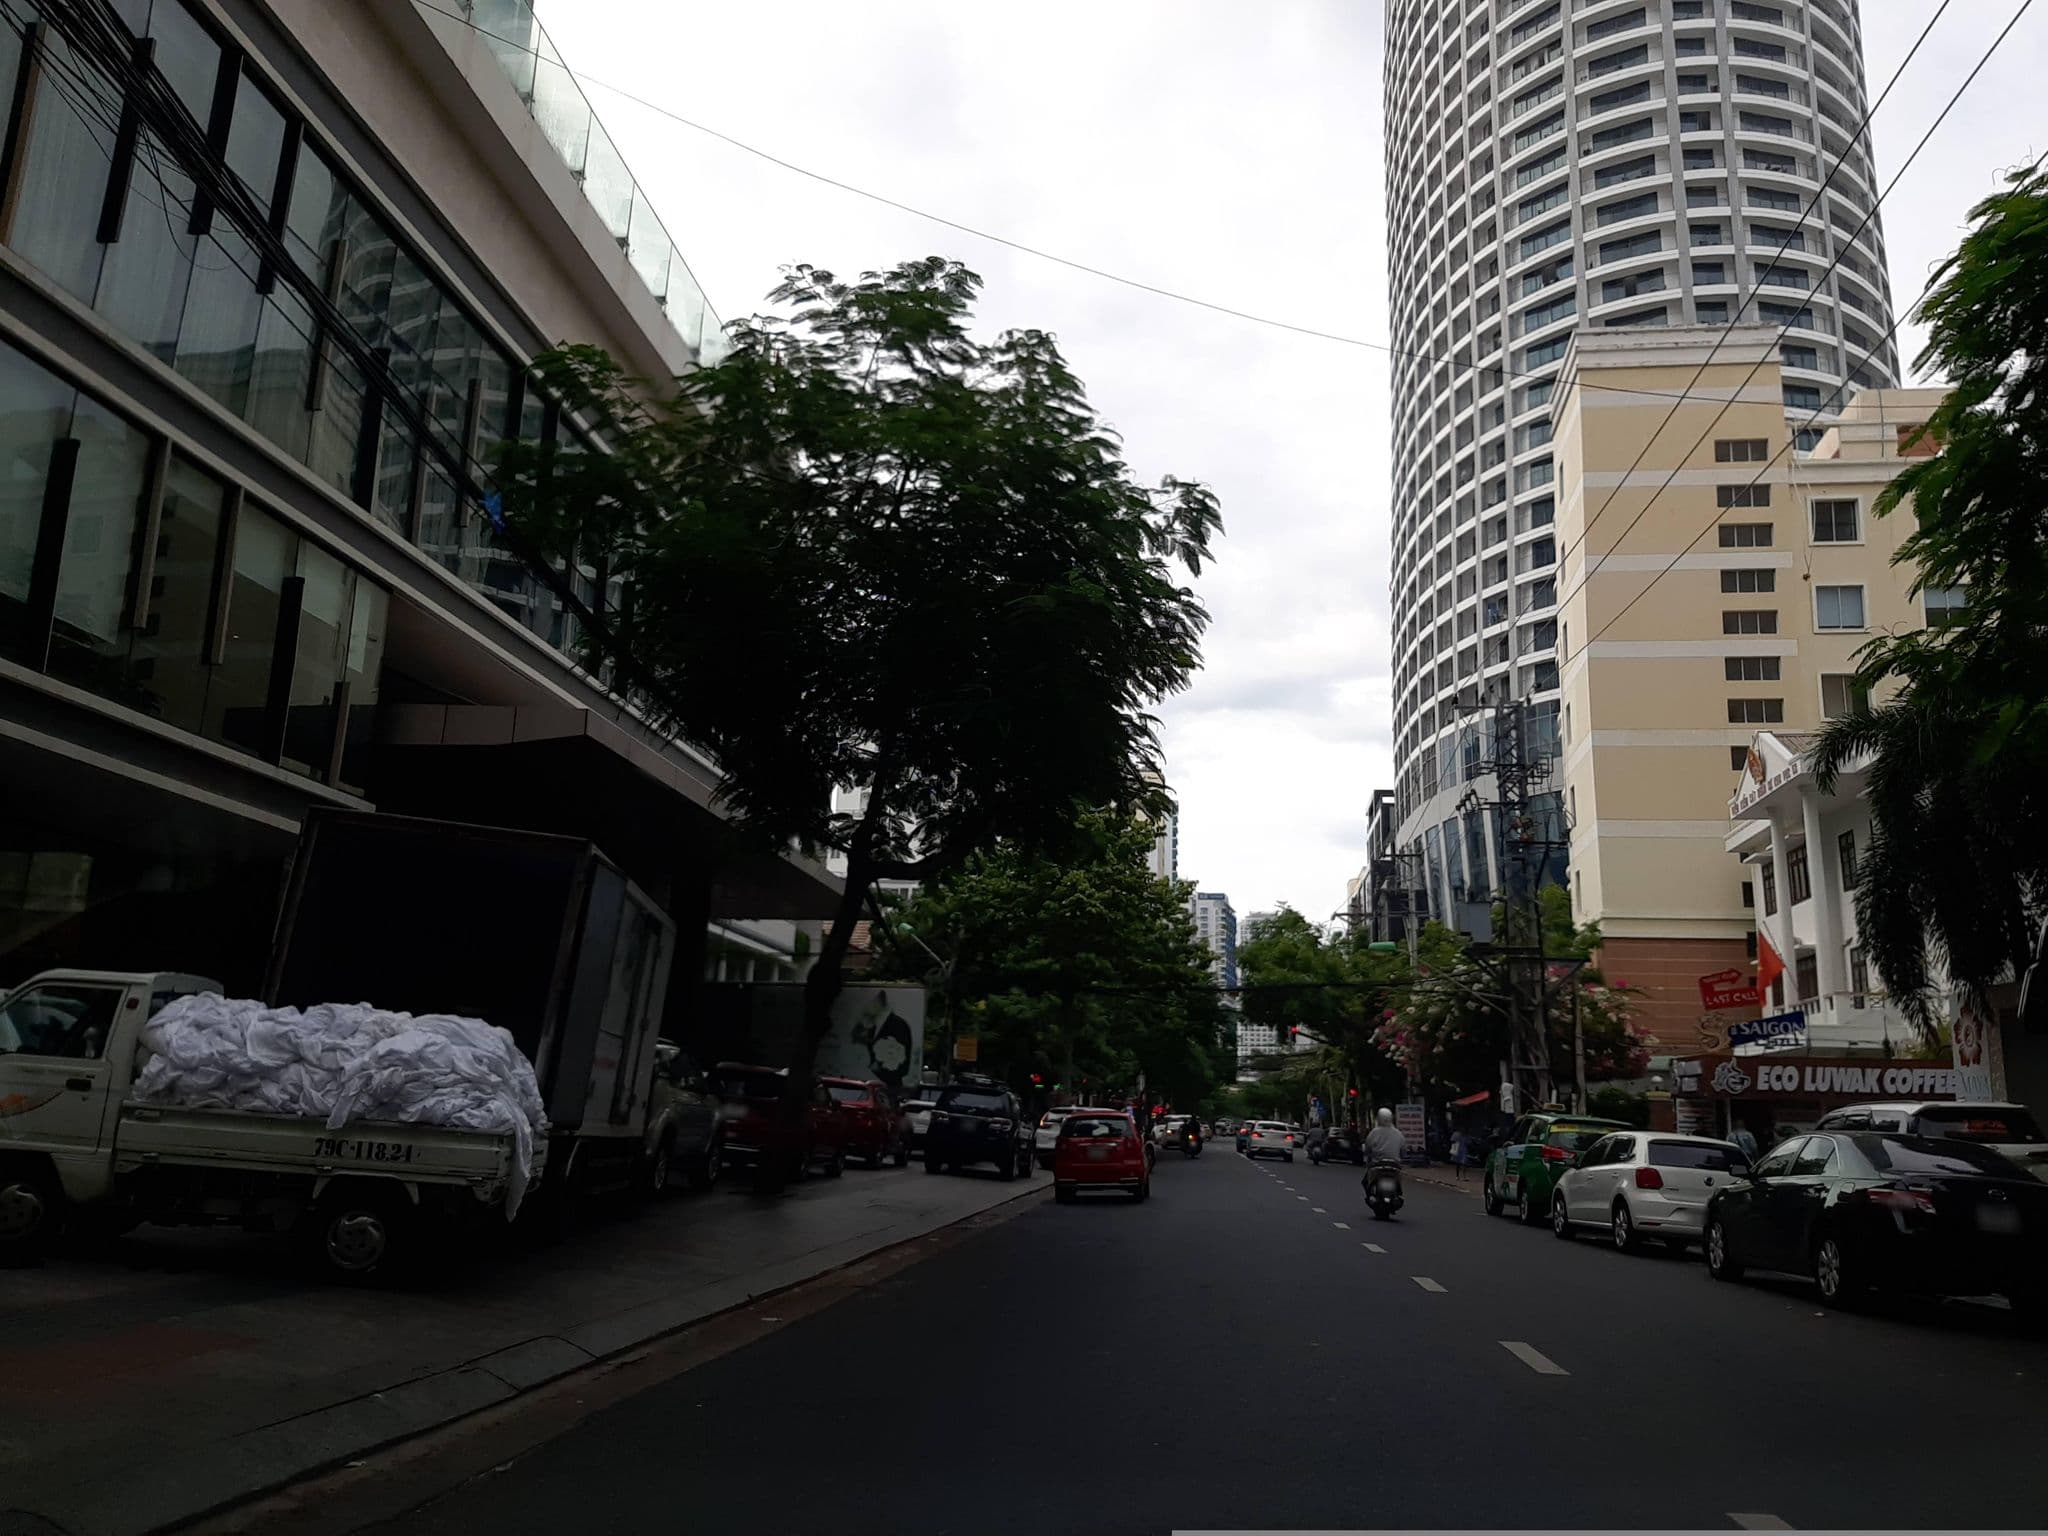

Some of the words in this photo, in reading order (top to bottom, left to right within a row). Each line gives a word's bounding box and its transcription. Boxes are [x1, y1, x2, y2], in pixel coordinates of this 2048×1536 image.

[1739, 1021, 1804, 1035] SAIGON
[1757, 1065, 1799, 1092] ECO
[1804, 1066, 1882, 1094] LUWAK
[1883, 1068, 1957, 1095] COFFEE
